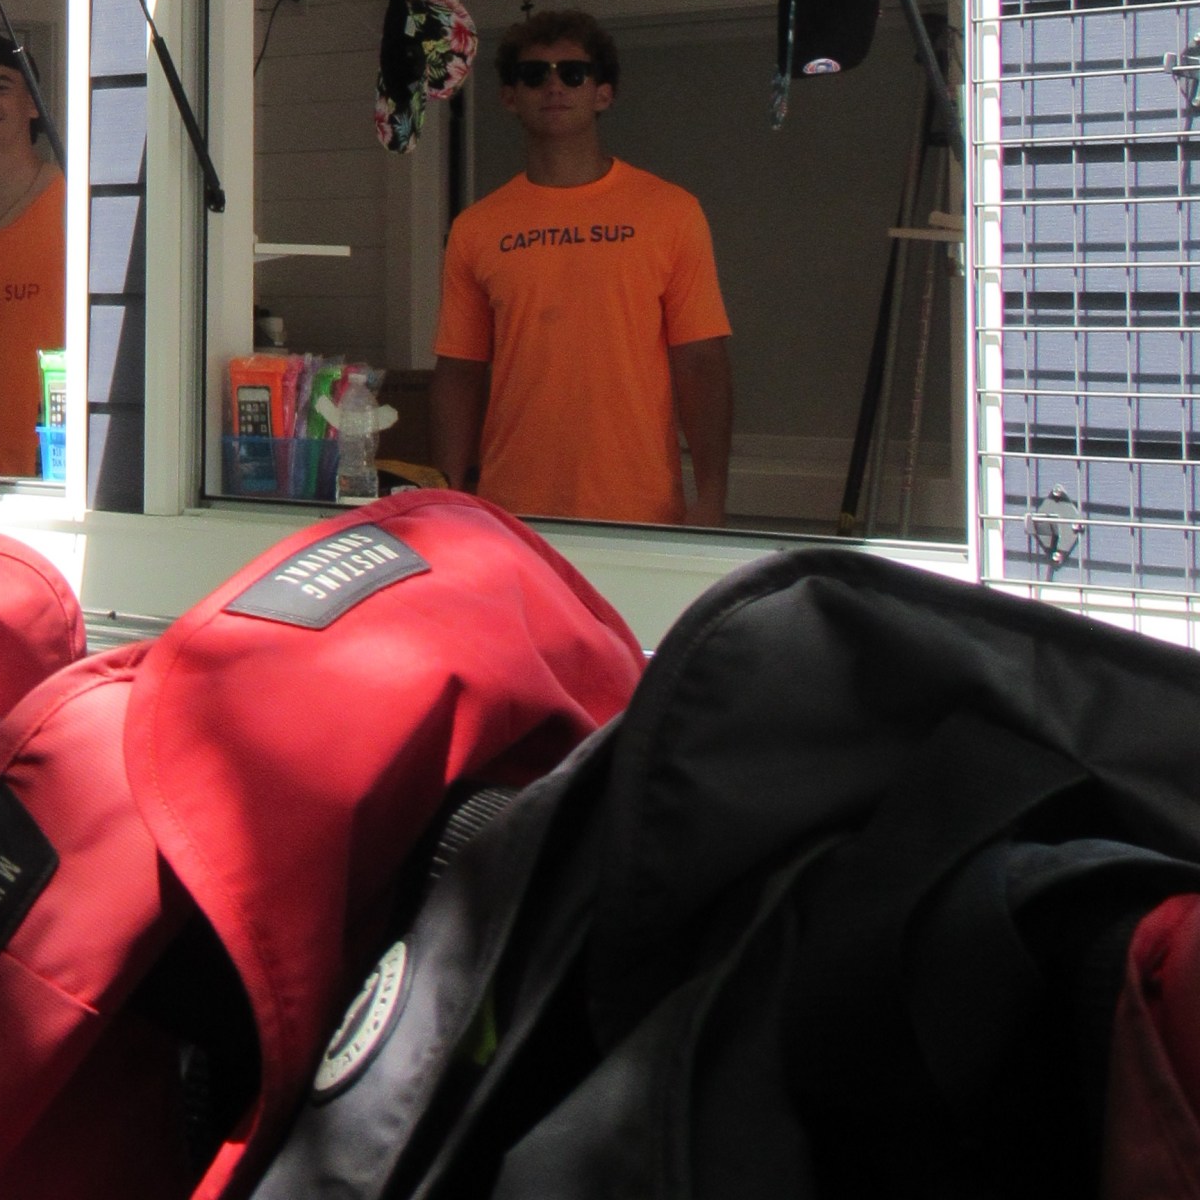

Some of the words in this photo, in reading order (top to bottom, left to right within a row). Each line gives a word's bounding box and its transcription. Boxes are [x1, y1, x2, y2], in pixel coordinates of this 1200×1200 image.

[499, 227, 585, 252] CAPITAL
[590, 225, 635, 243] SUP
[5, 283, 40, 302] SUP
[274, 533, 373, 585] SURVIVAL
[301, 542, 400, 600] MUSTANG
